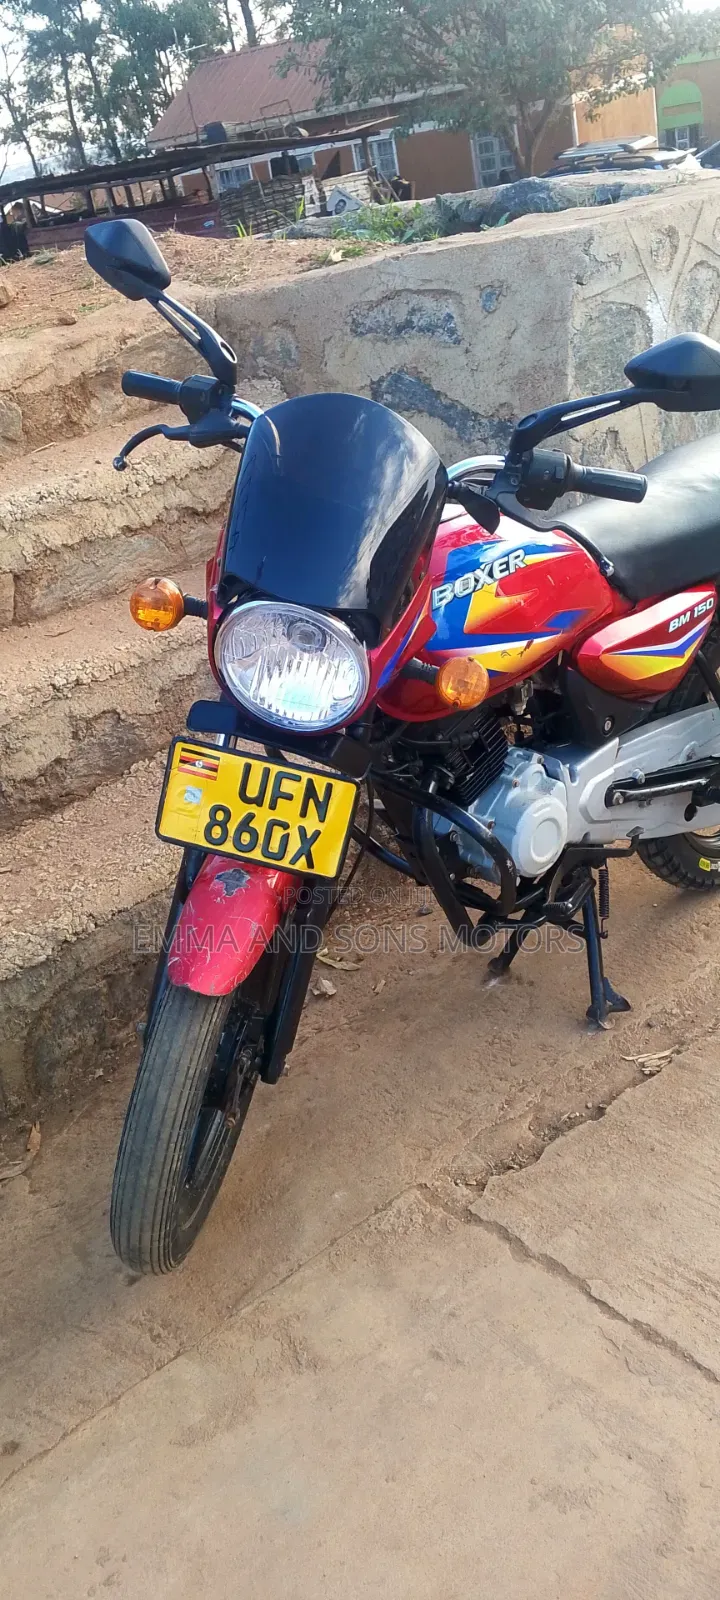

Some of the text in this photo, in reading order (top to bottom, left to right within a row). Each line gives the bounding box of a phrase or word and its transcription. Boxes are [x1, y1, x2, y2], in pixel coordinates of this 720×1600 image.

[432, 549, 528, 610] BOXER
[668, 598, 714, 633] BM 150
[238, 762, 333, 823] UFN
[204, 804, 321, 869] 860X
